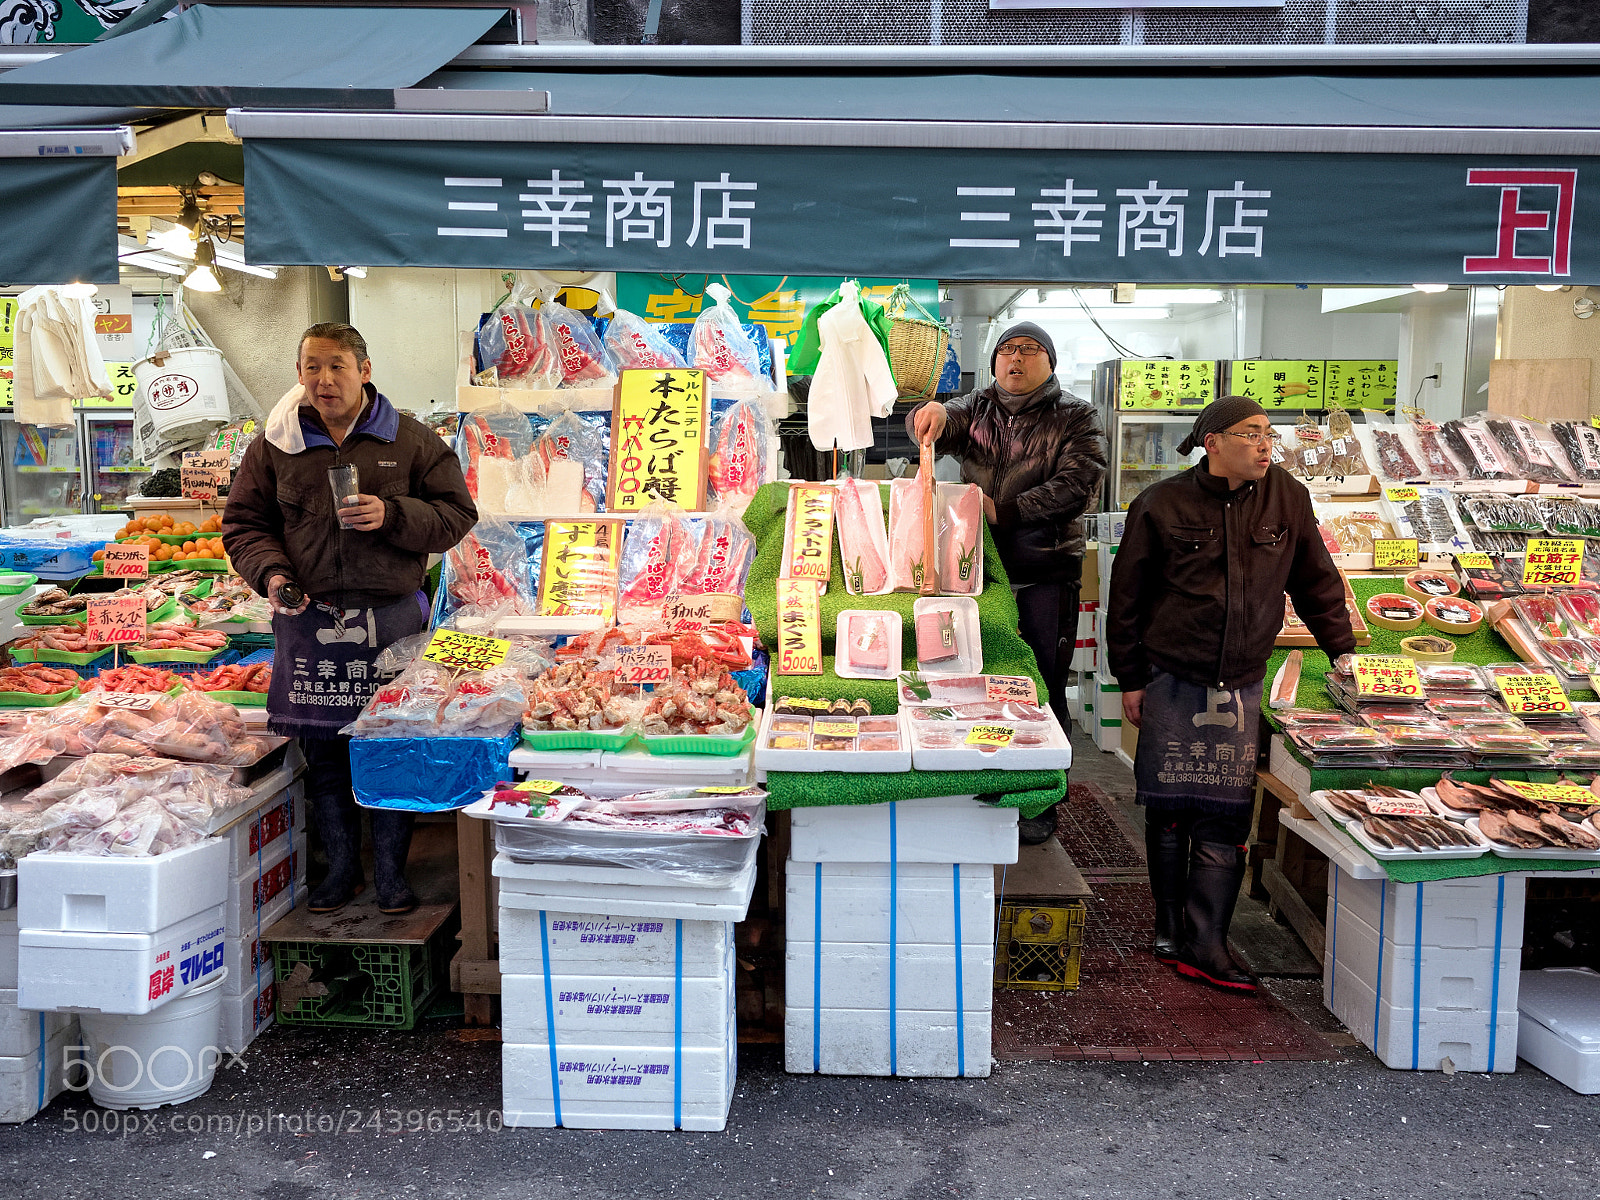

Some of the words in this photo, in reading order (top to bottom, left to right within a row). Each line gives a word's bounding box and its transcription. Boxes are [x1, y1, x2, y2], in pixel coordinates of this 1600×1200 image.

[437, 169, 757, 249] 三幸商店
[949, 178, 1272, 257] 三幸商店
[117, 366, 135, 395] えび
[1145, 363, 1156, 389] ほたて
[1180, 364, 1190, 389] あわび
[1243, 363, 1256, 396] にしん
[1307, 364, 1319, 398] たらこ
[1377, 364, 1387, 382] あじ
[1200, 378, 1210, 398] かき
[1273, 372, 1286, 406] 明太子
[1347, 377, 1355, 397] さば
[1362, 375, 1371, 397] いわし
[685, 371, 700, 438] マルハニチロ
[1528, 553, 1580, 564] 紅筋子
[99, 607, 142, 625] 赤えび
[782, 610, 807, 650] まぐろ
[617, 651, 667, 663] イバラガニ
[1358, 667, 1416, 678] 辛子明太子
[293, 680, 350, 693] 台東区上野
[1503, 686, 1562, 695] 甘口たらこ
[1165, 741, 1256, 762] 三幸商店
[1163, 761, 1218, 773] 台東区上野
[180, 942, 224, 986] マルヒロ
